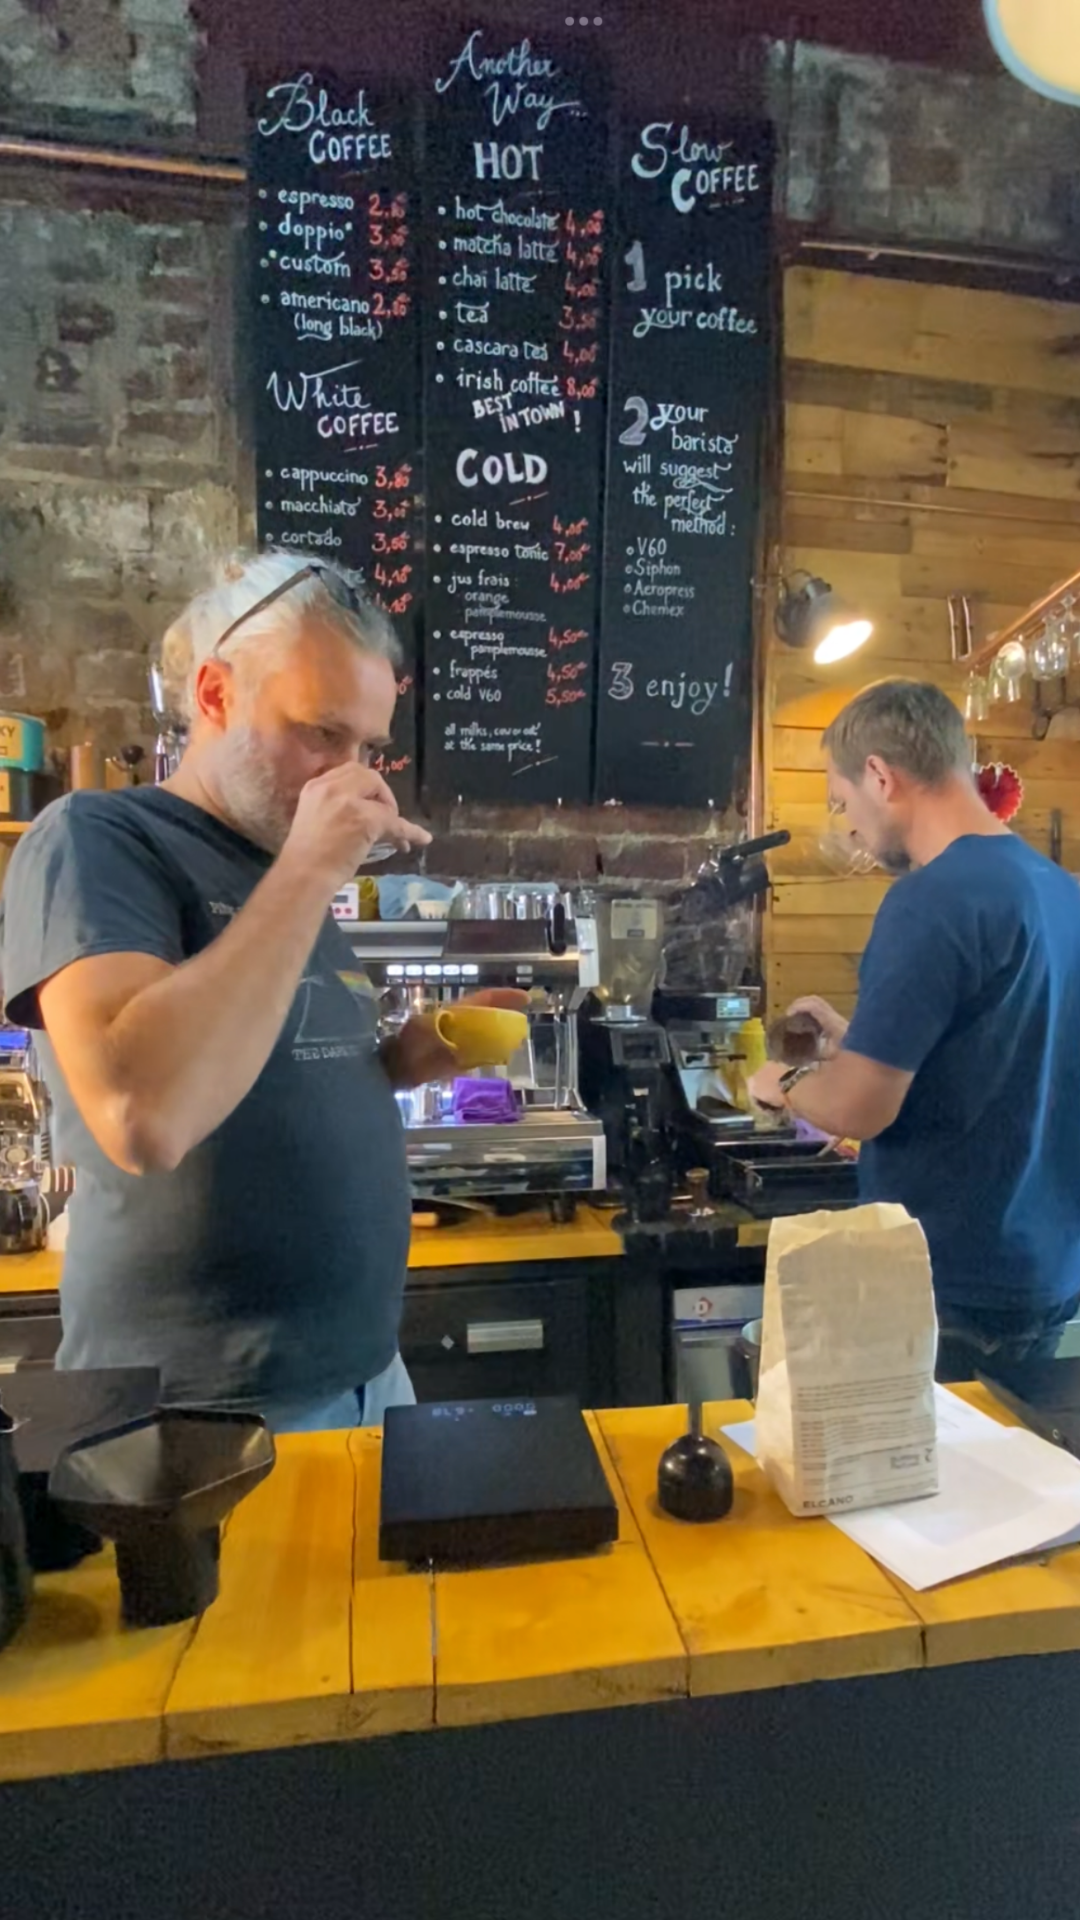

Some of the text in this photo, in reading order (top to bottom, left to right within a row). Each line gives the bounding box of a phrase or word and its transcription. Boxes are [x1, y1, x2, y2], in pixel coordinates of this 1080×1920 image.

[435, 30, 560, 93] Another
[258, 72, 375, 136] Black
[309, 130, 392, 164] COFFEE
[631, 121, 733, 178] Slow
[473, 142, 544, 180] HOT
[278, 189, 355, 215] espresso
[671, 165, 759, 214] COFFEE
[455, 195, 488, 221] hot
[491, 199, 560, 231] chocolate
[278, 212, 344, 251] doppio
[453, 234, 512, 256] matcha
[518, 235, 560, 263] latte
[279, 252, 351, 277] custom
[624, 240, 722, 308] 1 pick
[495, 266, 537, 293] latte
[280, 291, 370, 314] americano
[455, 301, 490, 324] tea
[294, 313, 383, 341] (long black)
[632, 307, 758, 338] your coffee
[453, 339, 519, 358] cascara
[523, 341, 548, 361] tea
[266, 358, 371, 411] White
[456, 368, 503, 392] irish
[510, 371, 562, 397] coffee
[472, 392, 513, 419] BEST
[518, 400, 565, 427] TOWN
[317, 412, 399, 438] COFFEE
[618, 396, 709, 446] 2 your
[671, 426, 739, 455] barista
[280, 468, 368, 492] cappuccino
[456, 448, 548, 488] COLD
[623, 453, 733, 493] will suggest
[281, 494, 361, 516] macchiato
[632, 481, 725, 520] the perfect
[451, 508, 487, 527] cold
[496, 511, 530, 531] brew
[281, 527, 342, 546] cortado
[637, 537, 667, 557] V60
[449, 543, 510, 564] espresso
[514, 542, 549, 561] tonic
[447, 571, 473, 594] jus
[634, 558, 681, 582] Siphon
[464, 591, 510, 609] orange
[633, 579, 695, 604] Aeropress
[632, 600, 684, 617] Chemex
[450, 629, 504, 647] espresso
[470, 643, 548, 661] pamplemousse
[450, 659, 498, 684] frappés
[608, 662, 634, 700] 3
[446, 685, 471, 701] cold
[478, 689, 502, 703] V60
[444, 723, 456, 736] all
[444, 740, 455, 751] at
[481, 743, 505, 751] same
[803, 1495, 854, 1509] ELCANO
